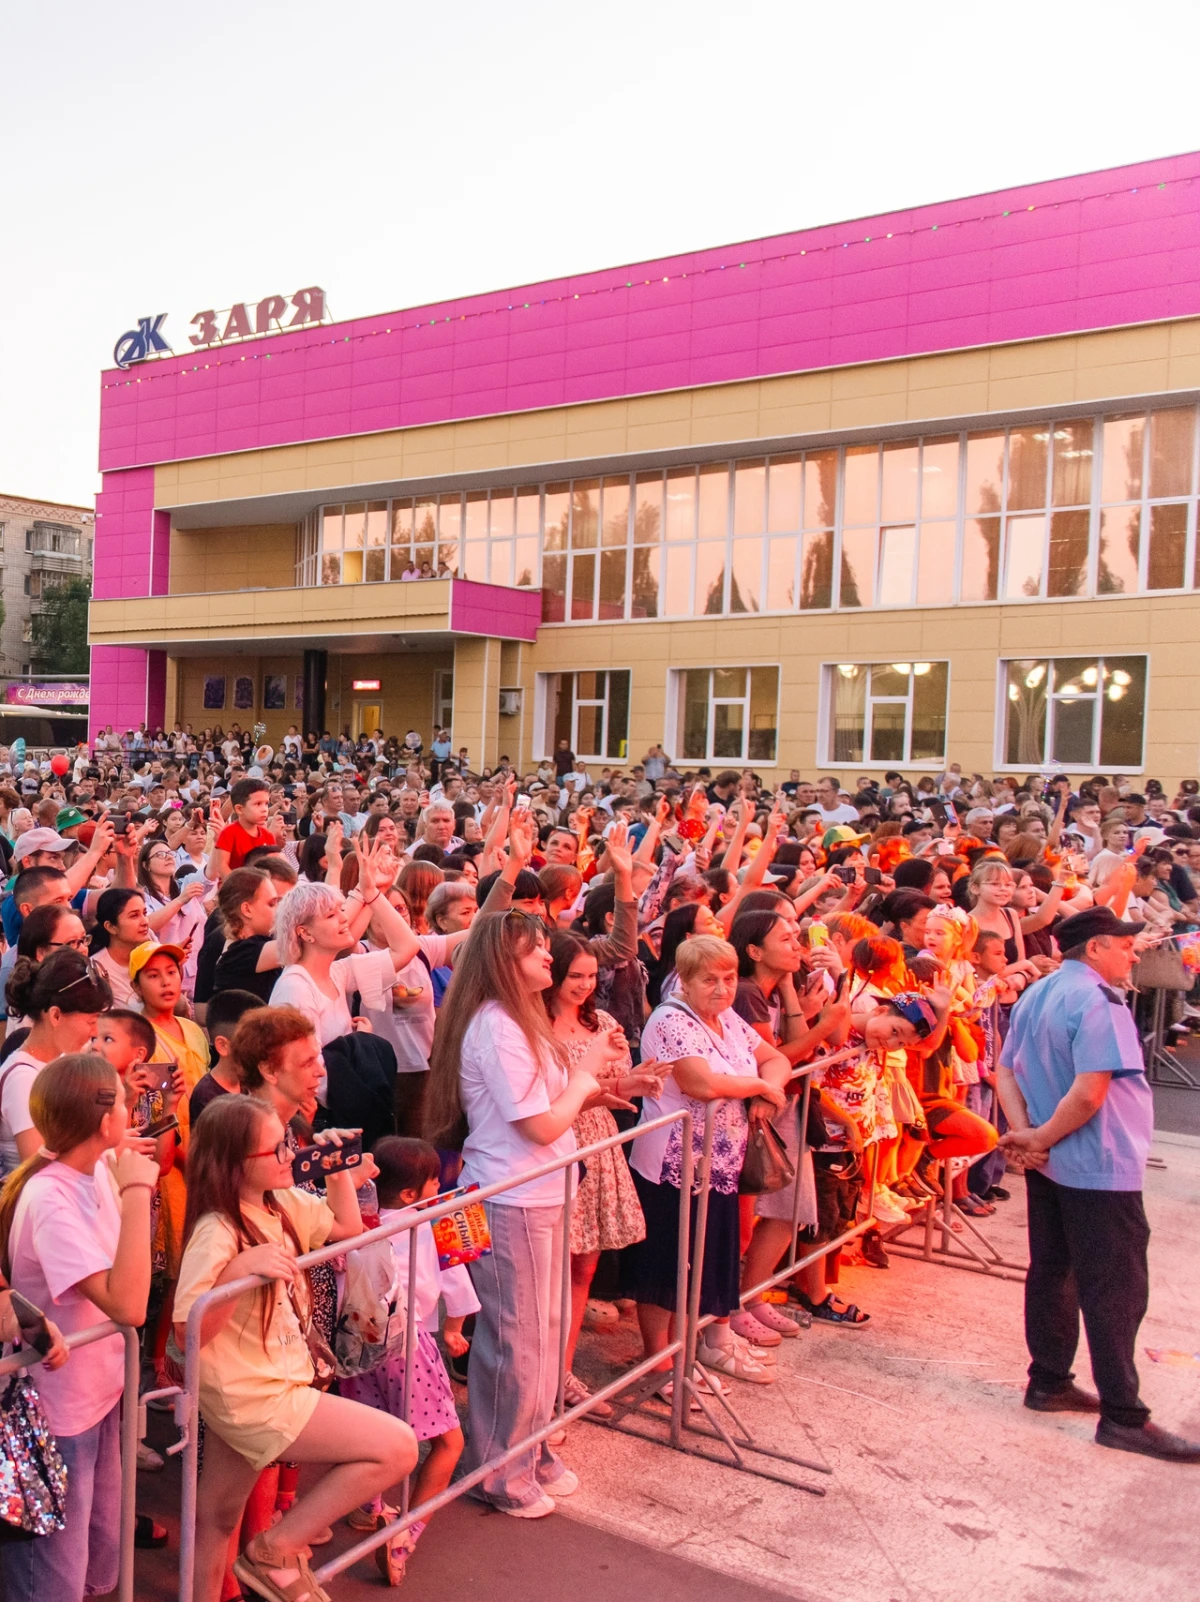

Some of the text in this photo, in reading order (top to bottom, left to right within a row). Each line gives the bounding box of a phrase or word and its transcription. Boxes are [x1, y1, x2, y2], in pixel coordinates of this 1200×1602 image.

[188, 286, 326, 346] ЗАРЯ
[17, 688, 25, 698] С
[26, 688, 55, 700] Днем
[440, 1217, 457, 1245] 65
[453, 1210, 474, 1252] СНЫЙ!
[463, 1206, 480, 1244] ОЖДЕНИЯ
